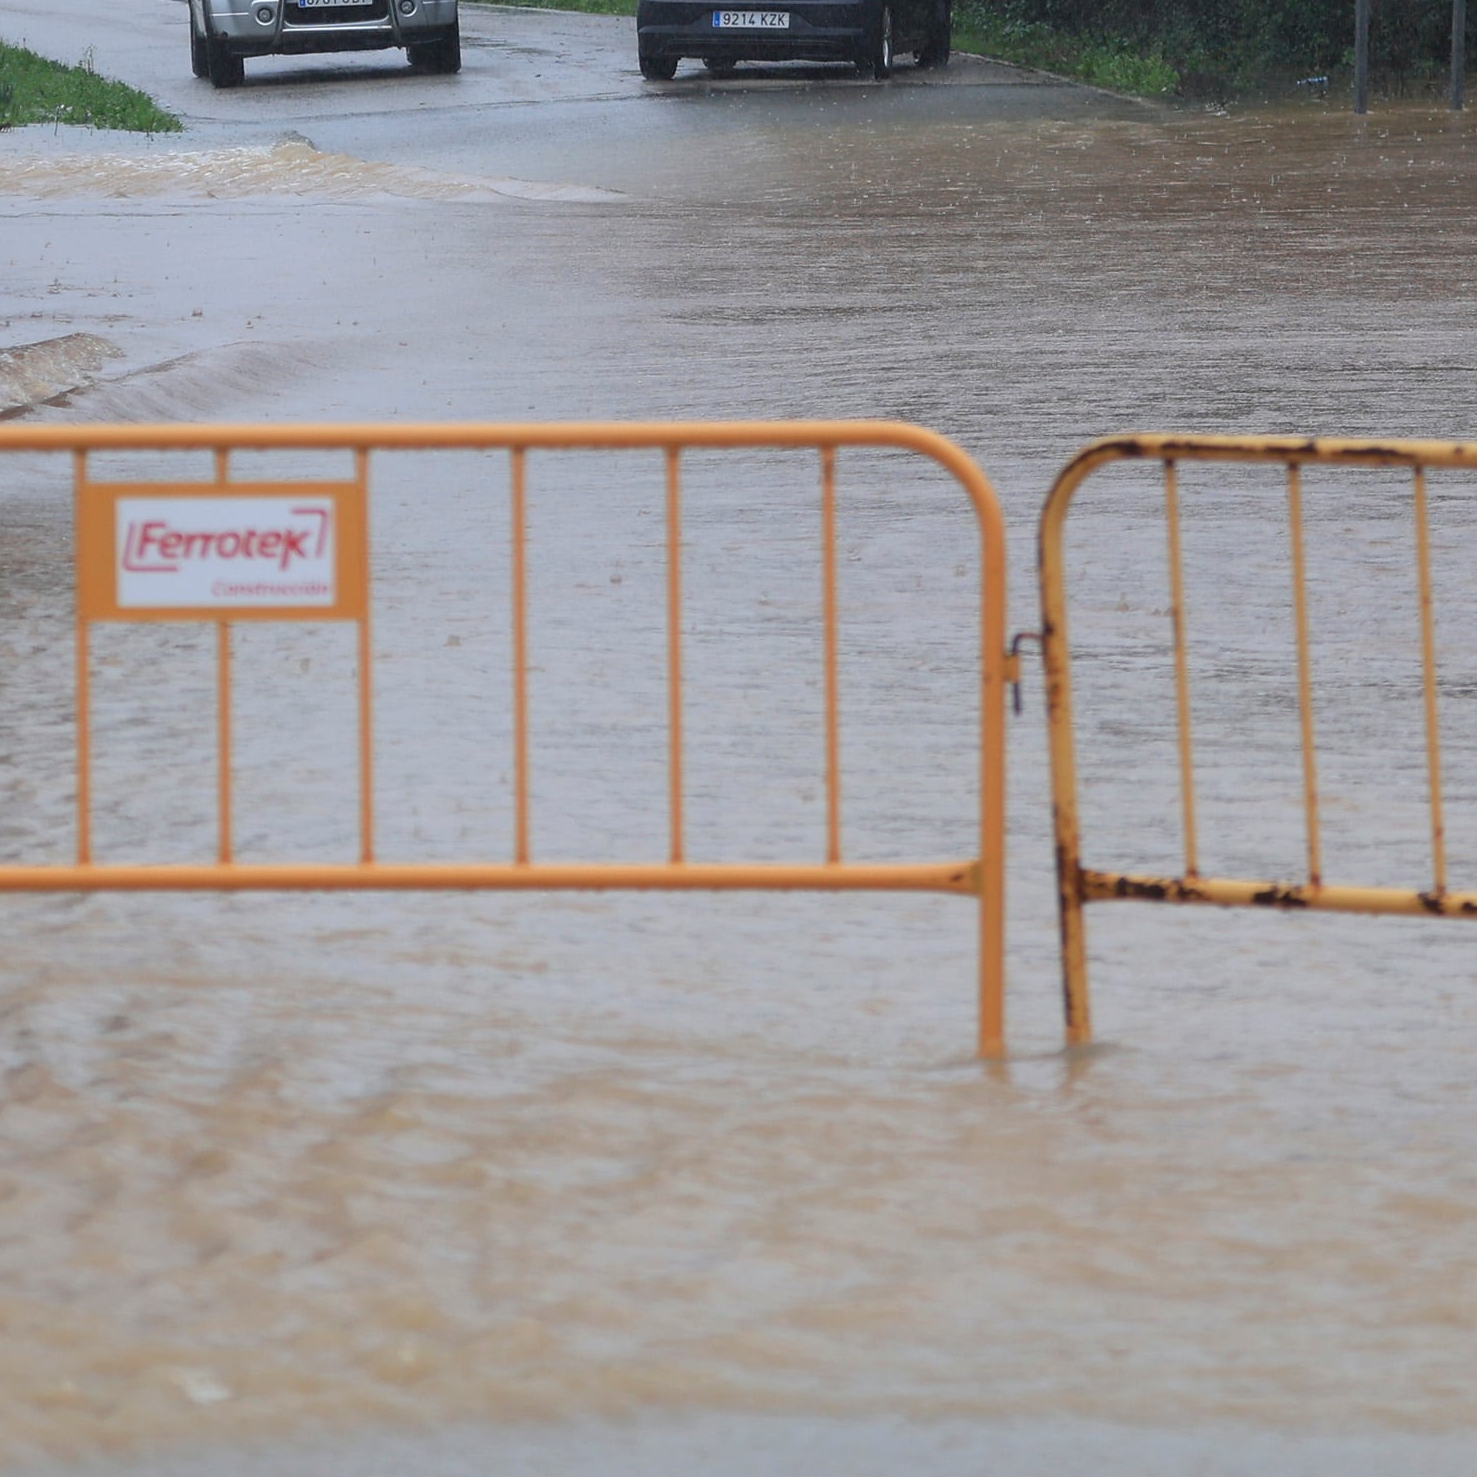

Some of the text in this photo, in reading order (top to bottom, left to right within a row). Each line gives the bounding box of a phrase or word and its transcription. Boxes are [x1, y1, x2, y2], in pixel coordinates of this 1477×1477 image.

[723, 12, 786, 26] 9214 KZK
[135, 521, 311, 571] Ferrotek
